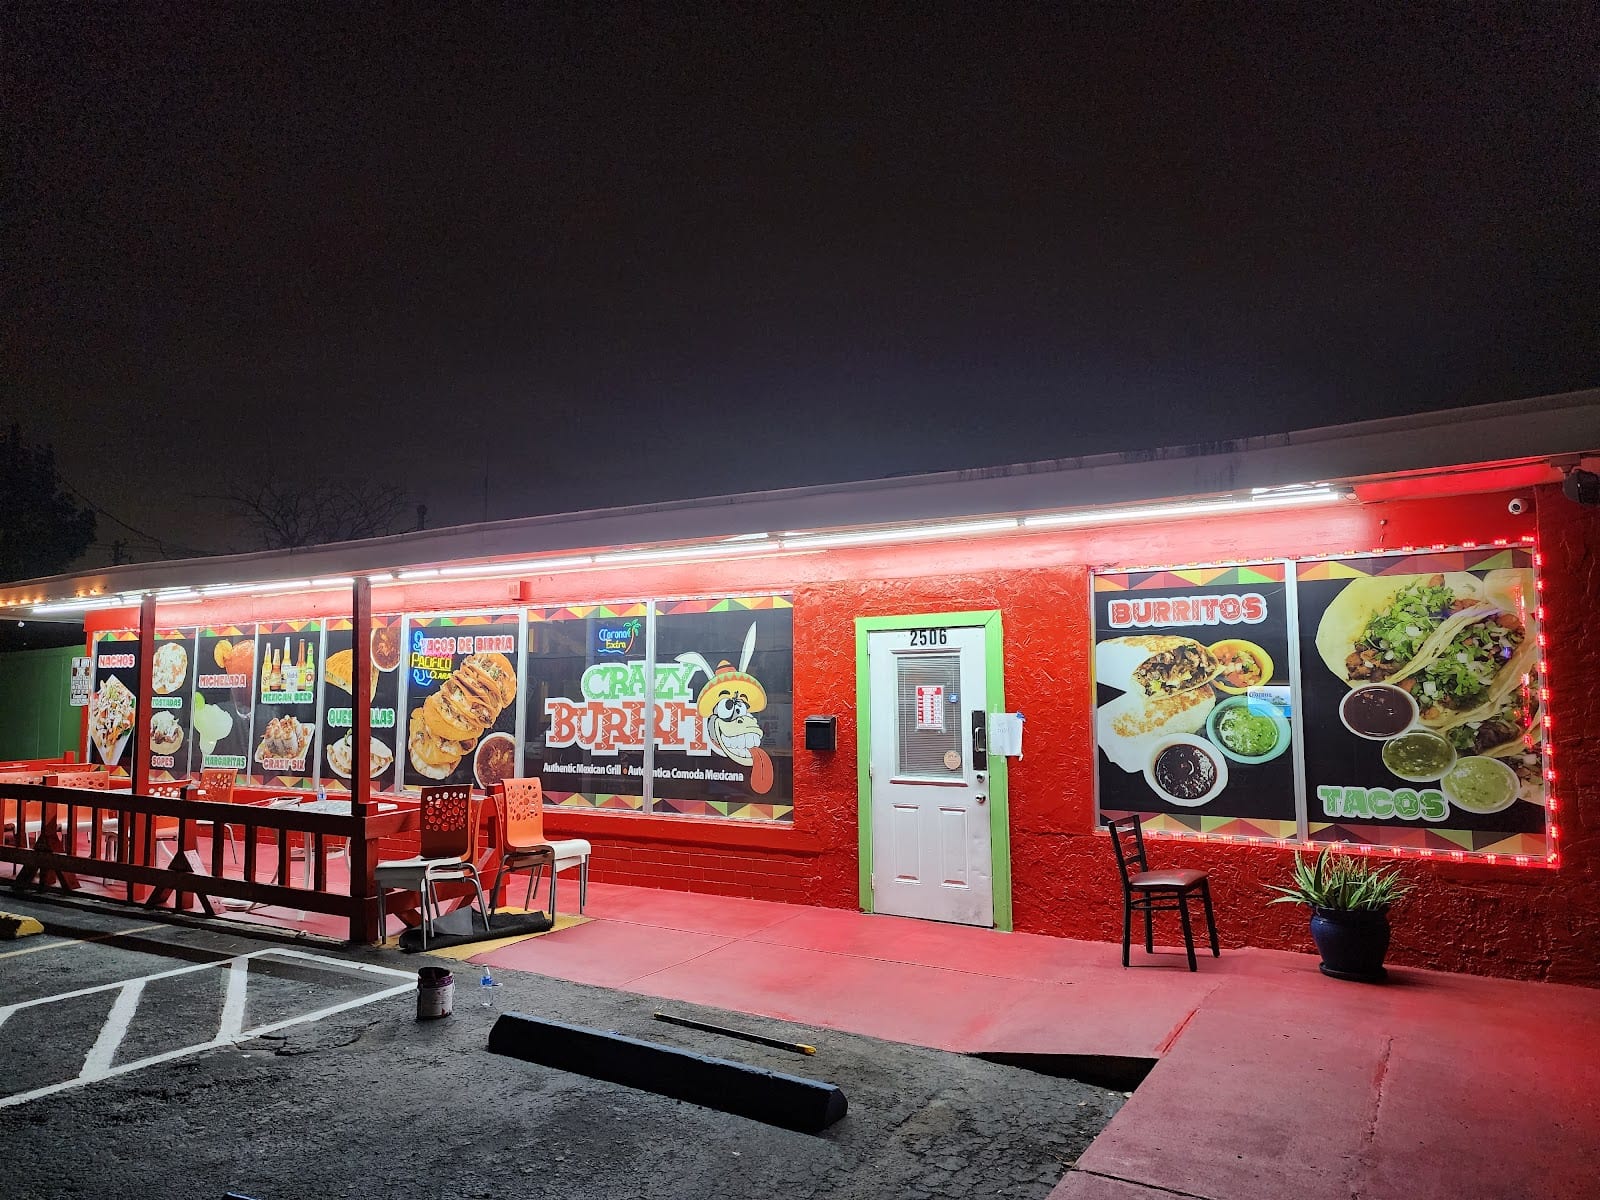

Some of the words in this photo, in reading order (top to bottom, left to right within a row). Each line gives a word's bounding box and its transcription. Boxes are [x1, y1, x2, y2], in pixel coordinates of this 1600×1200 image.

[1111, 595, 1264, 625] BURRITOS
[598, 628, 628, 642] Corona
[909, 628, 948, 647] 2506
[421, 637, 456, 654] TACOS
[458, 637, 473, 653] DE
[475, 635, 514, 652] BIRRIA
[99, 655, 135, 667] NACHOS
[411, 652, 453, 670] PACIFICO
[199, 674, 247, 688] MICHELADA
[584, 663, 698, 700] CRAZY
[262, 692, 293, 703] MEXICAN
[294, 691, 313, 702] BEER
[329, 708, 395, 727] QUESLLAS
[547, 700, 723, 751] BURRIT
[152, 756, 174, 767] SOPES
[204, 756, 246, 768] MARGARITAS
[263, 759, 291, 770] CRAZY
[291, 759, 305, 770] SIX
[543, 762, 577, 773] Authentic
[576, 763, 606, 775] Mexican
[606, 764, 622, 775] Grill
[705, 769, 744, 782] Mexicana
[1319, 786, 1447, 819] TACOS
